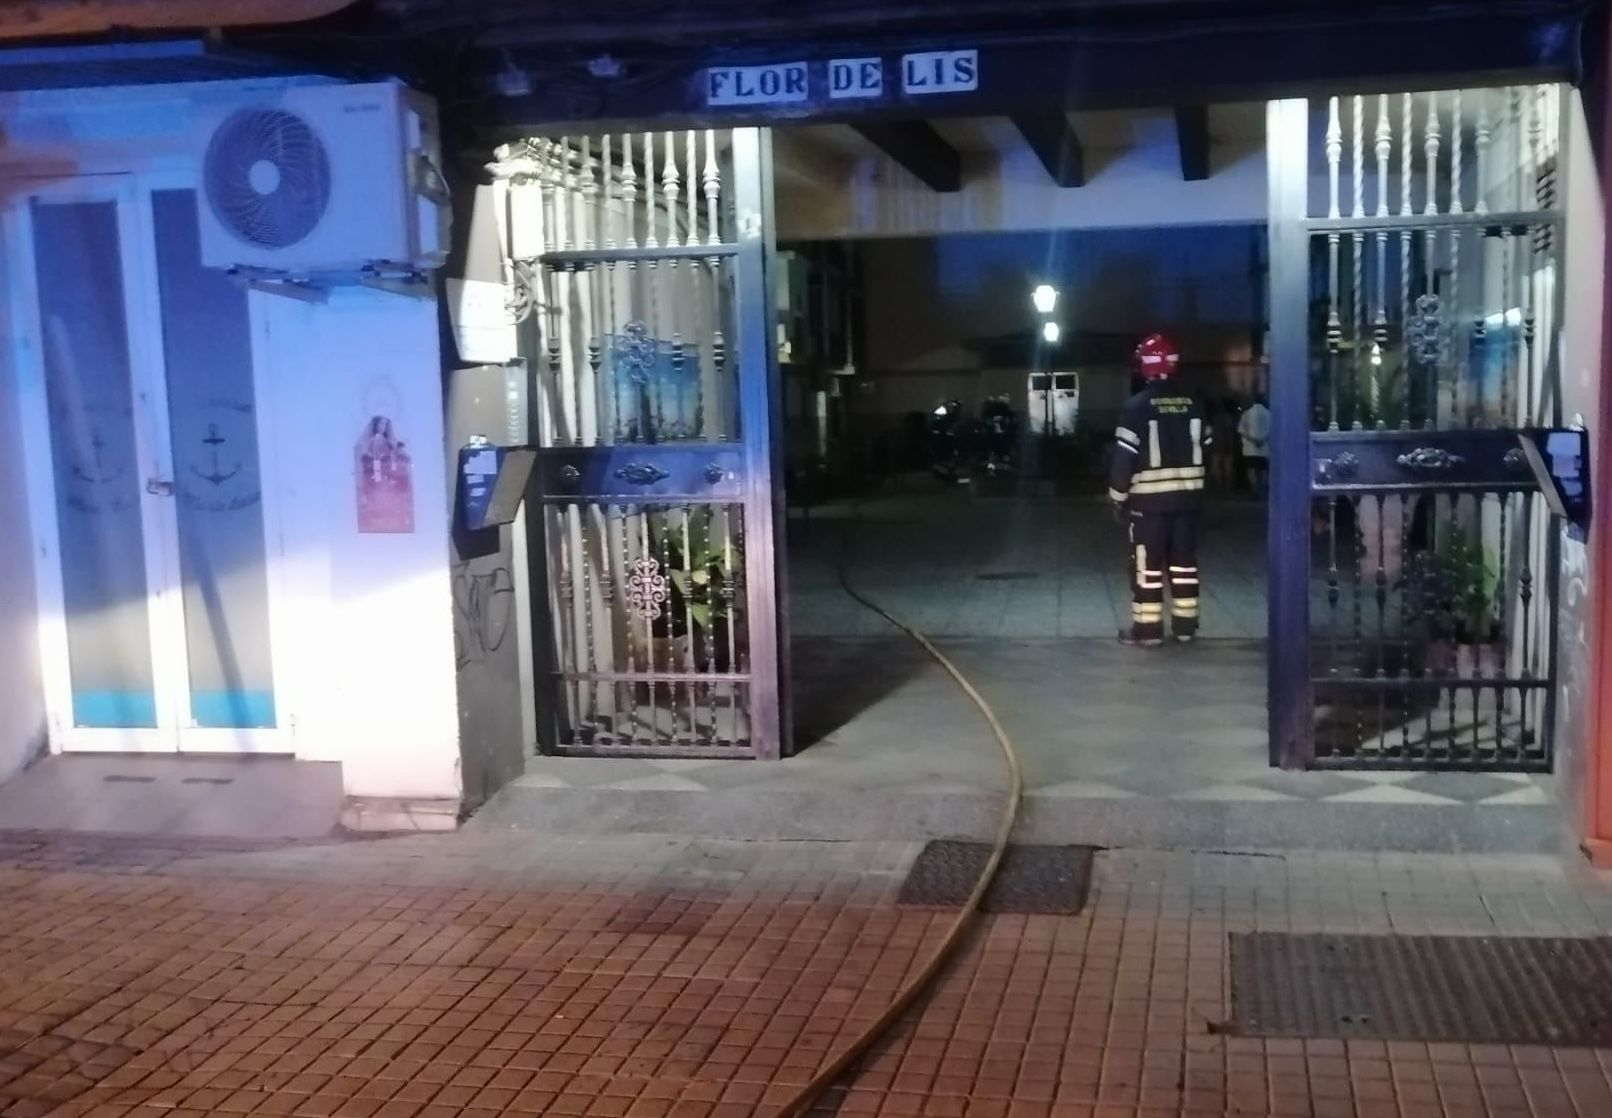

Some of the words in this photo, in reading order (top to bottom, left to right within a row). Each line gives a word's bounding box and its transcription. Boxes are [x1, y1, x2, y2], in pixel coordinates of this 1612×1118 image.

[709, 66, 806, 98] FLOR
[833, 62, 881, 91] DE
[906, 56, 974, 86] LIS
